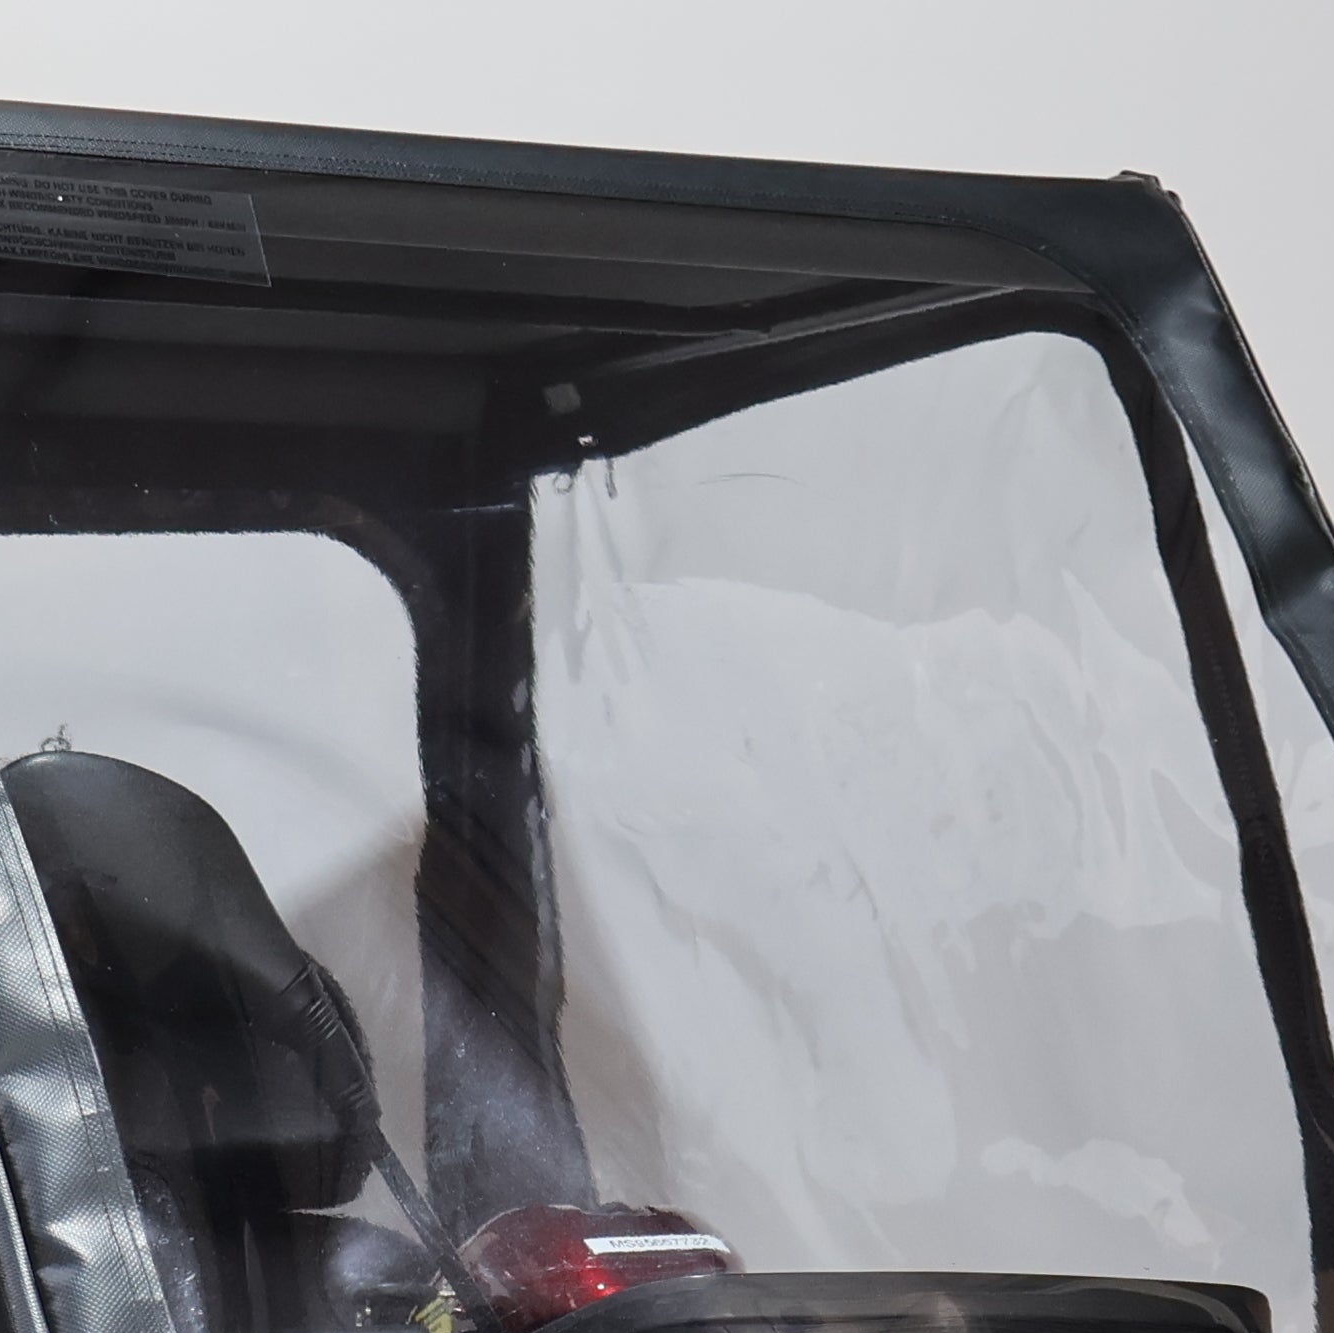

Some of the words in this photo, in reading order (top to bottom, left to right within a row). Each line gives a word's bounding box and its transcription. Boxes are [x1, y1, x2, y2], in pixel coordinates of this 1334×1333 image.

[34, 180, 51, 189] DO
[53, 182, 74, 191] NOT
[79, 185, 99, 193] USE
[130, 189, 168, 200] COVER
